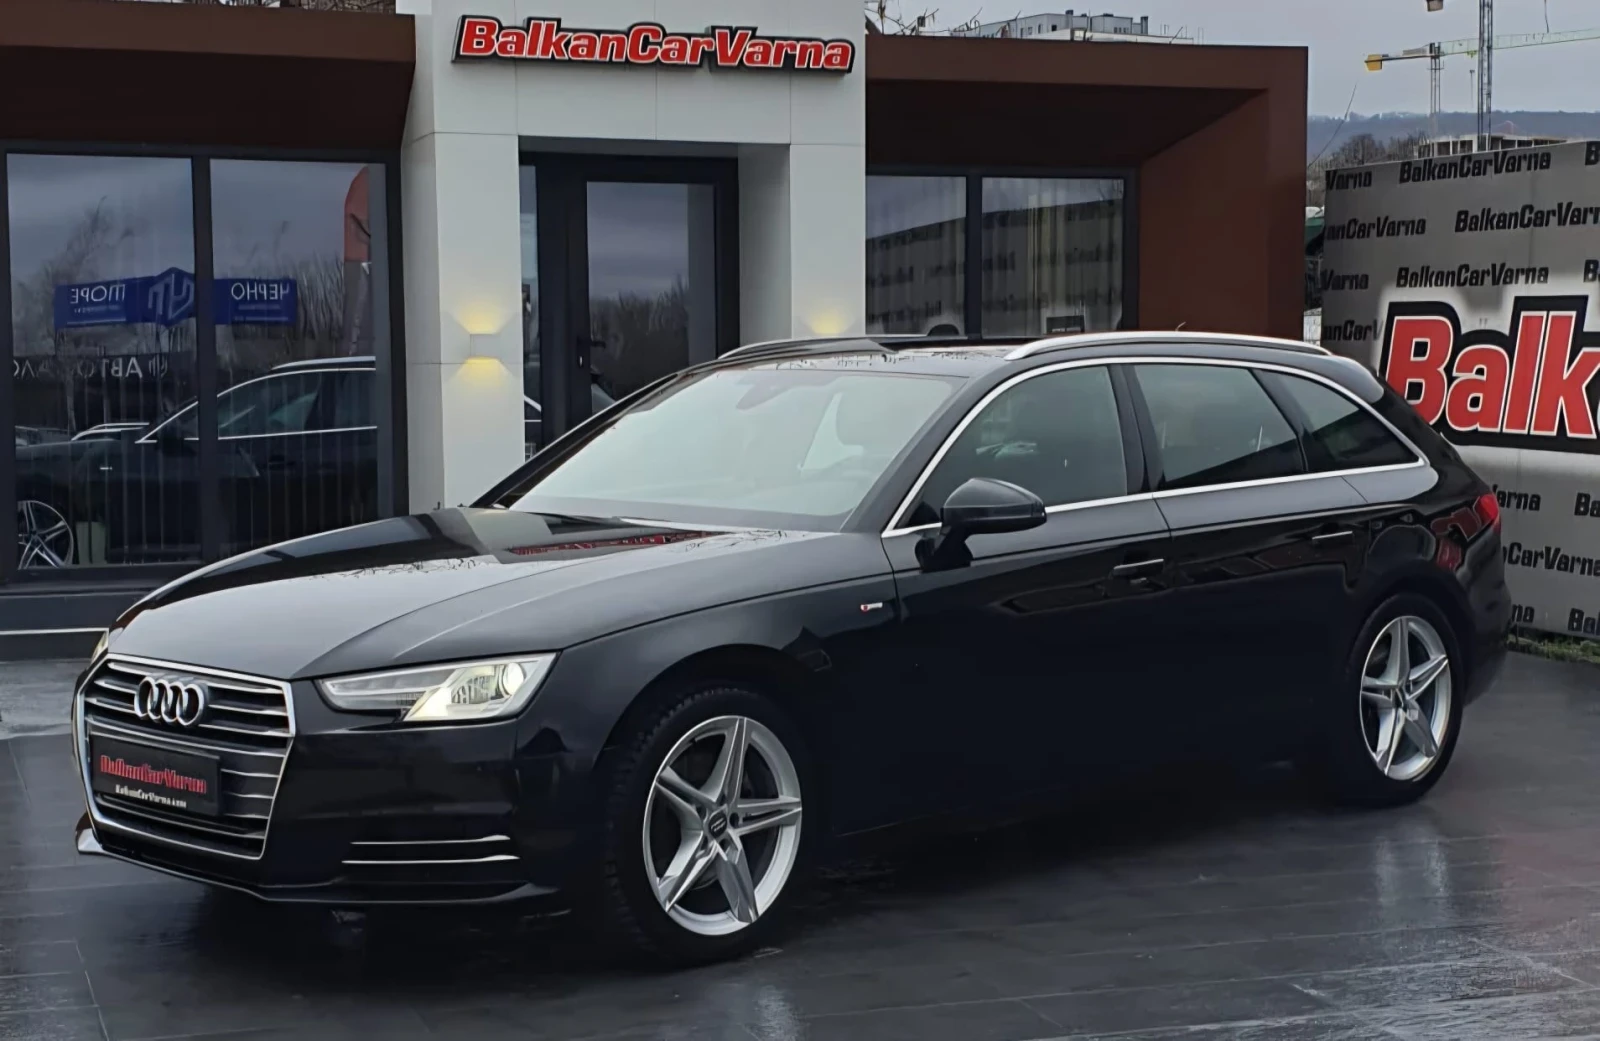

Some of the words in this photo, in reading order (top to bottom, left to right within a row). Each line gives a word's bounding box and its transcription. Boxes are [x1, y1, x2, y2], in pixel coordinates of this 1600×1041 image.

[459, 17, 852, 70] BalkanCarVarna
[1399, 151, 1550, 184] BalkanCarVarna
[1396, 263, 1549, 288] BalkanCarVarna
